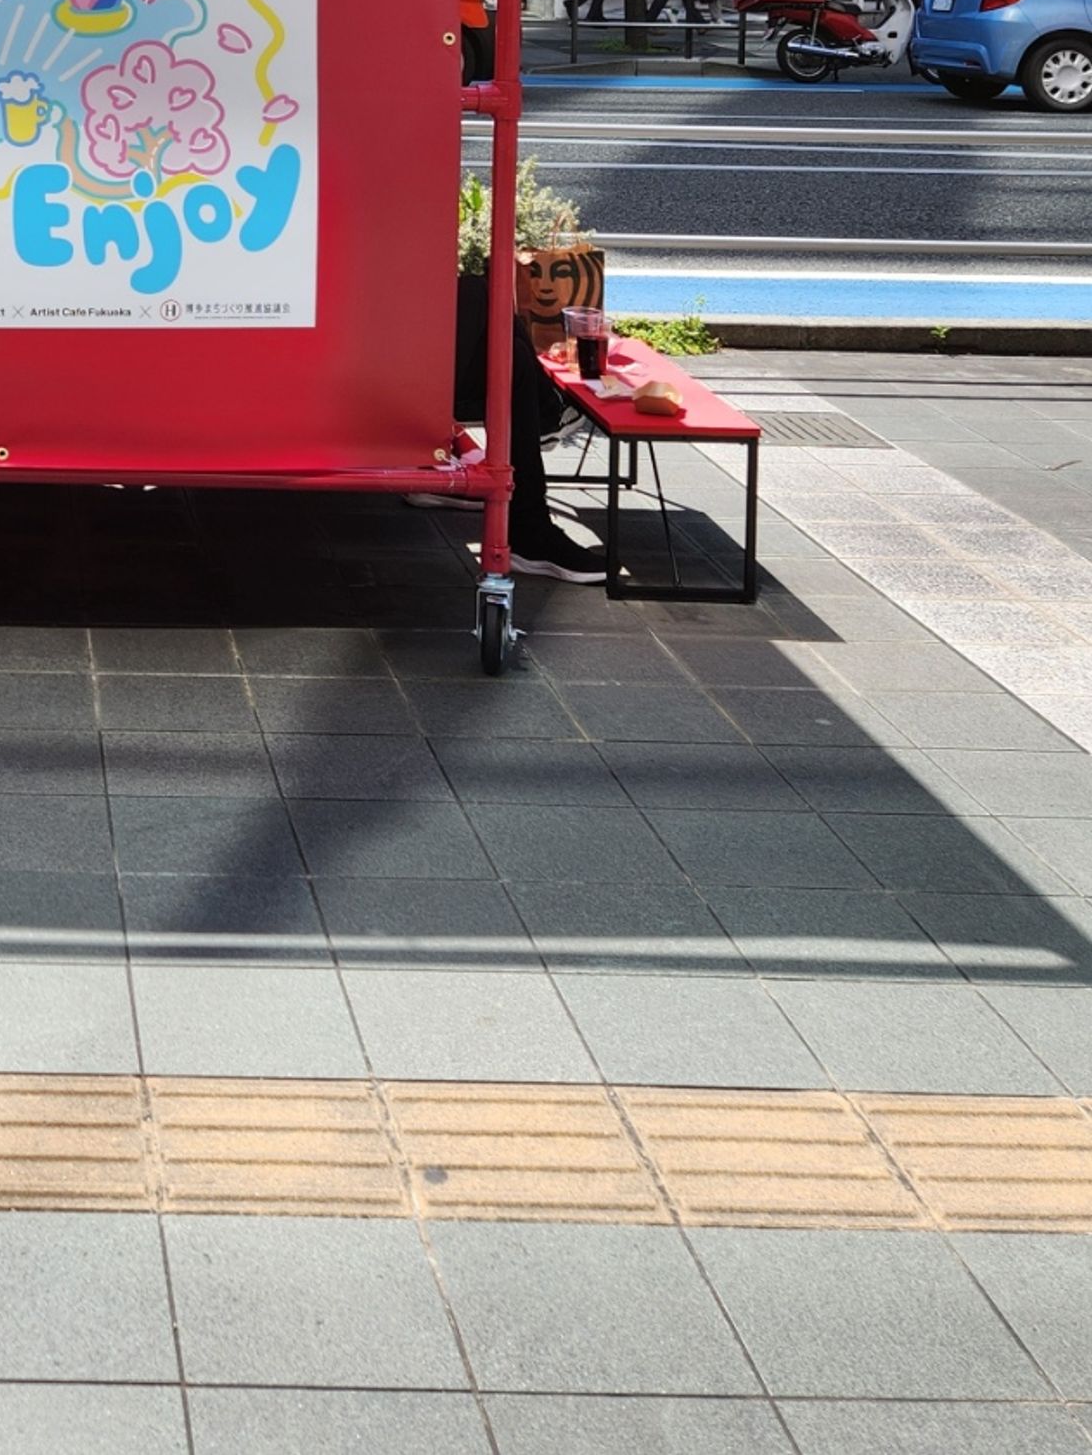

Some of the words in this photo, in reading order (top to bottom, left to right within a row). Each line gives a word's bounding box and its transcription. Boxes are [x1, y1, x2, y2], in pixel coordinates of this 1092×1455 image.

[12, 143, 300, 295] Enjoy
[30, 306, 60, 317] Artist
[88, 306, 132, 318] Fukuoka
